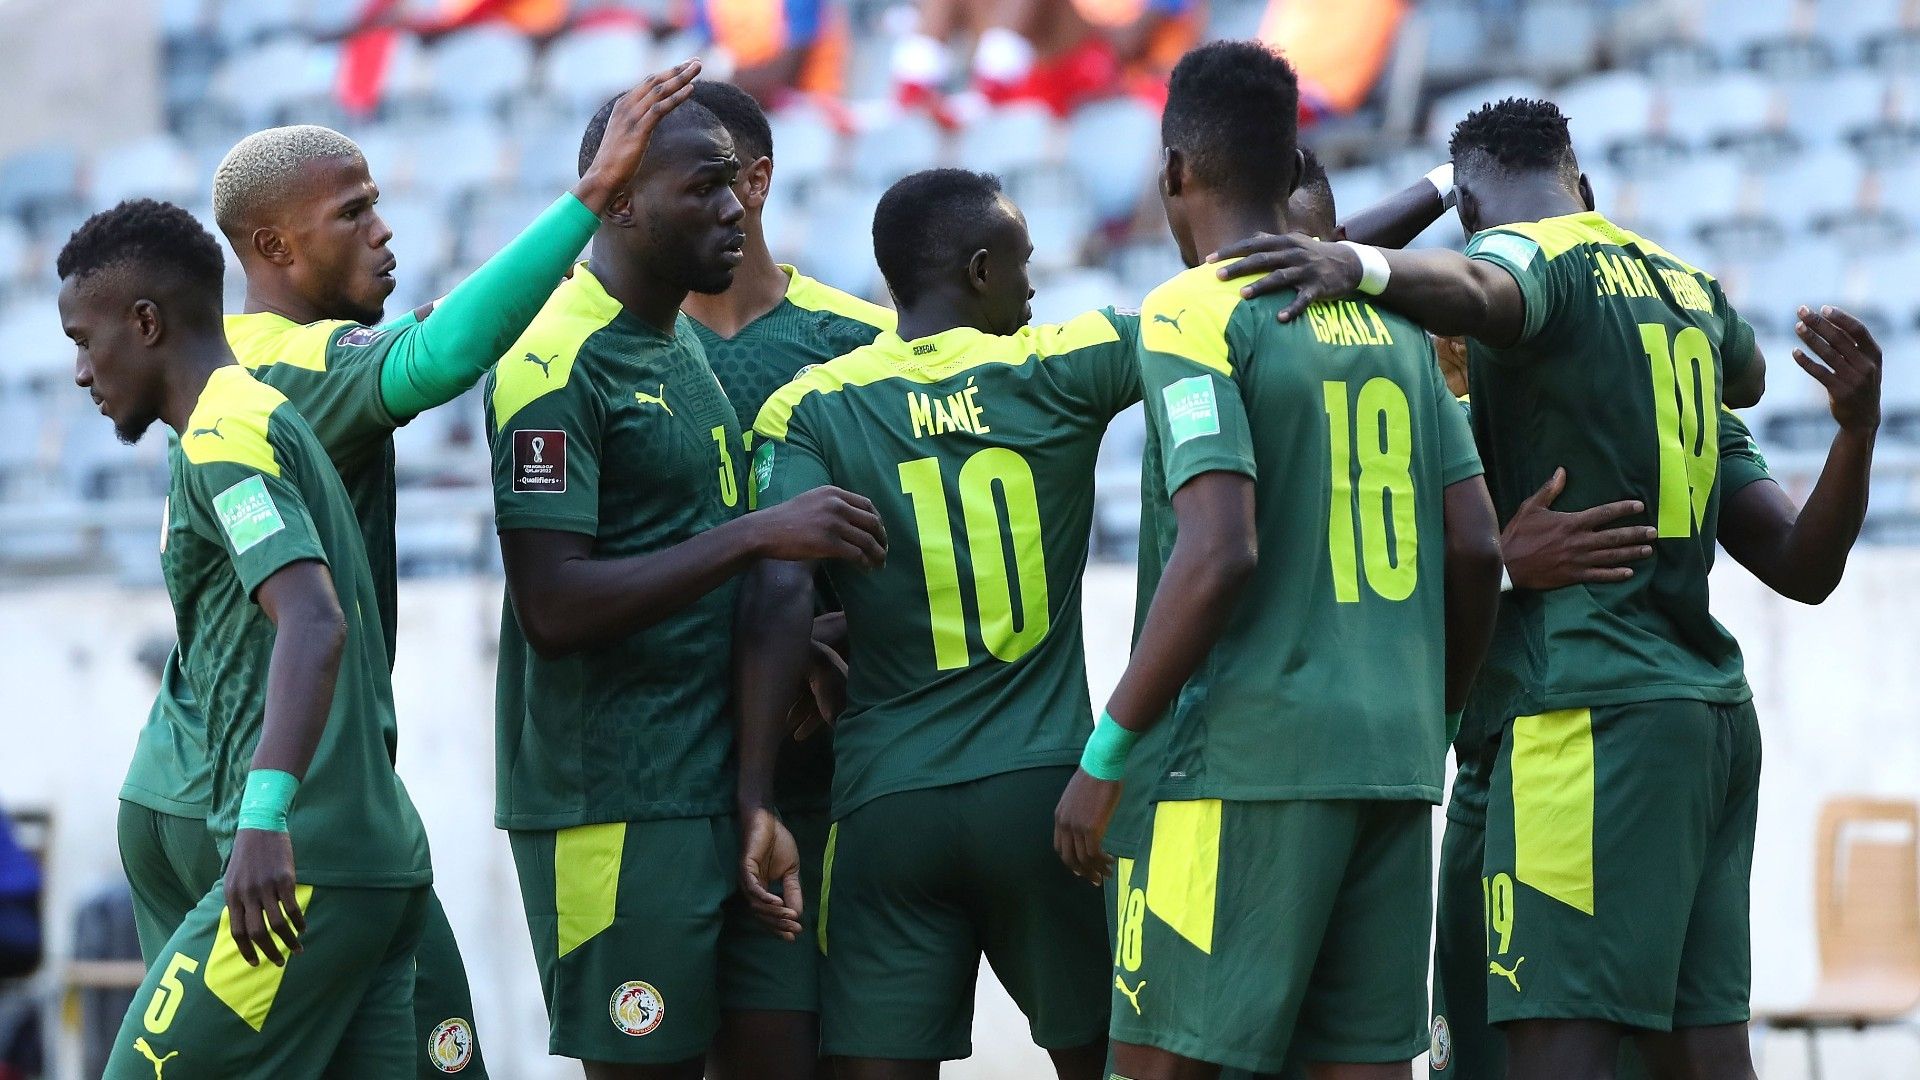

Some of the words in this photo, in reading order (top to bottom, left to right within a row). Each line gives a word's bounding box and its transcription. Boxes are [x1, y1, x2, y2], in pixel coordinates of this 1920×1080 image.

[913, 343, 937, 356] SENEGAL
[1307, 300, 1393, 345] ISMAILA
[907, 376, 990, 438] MANÉ
[521, 476, 555, 485] Qualifiers
[711, 425, 738, 507] 3
[1323, 377, 1417, 603] 18
[898, 447, 1050, 671] 10
[143, 951, 199, 1034] 5
